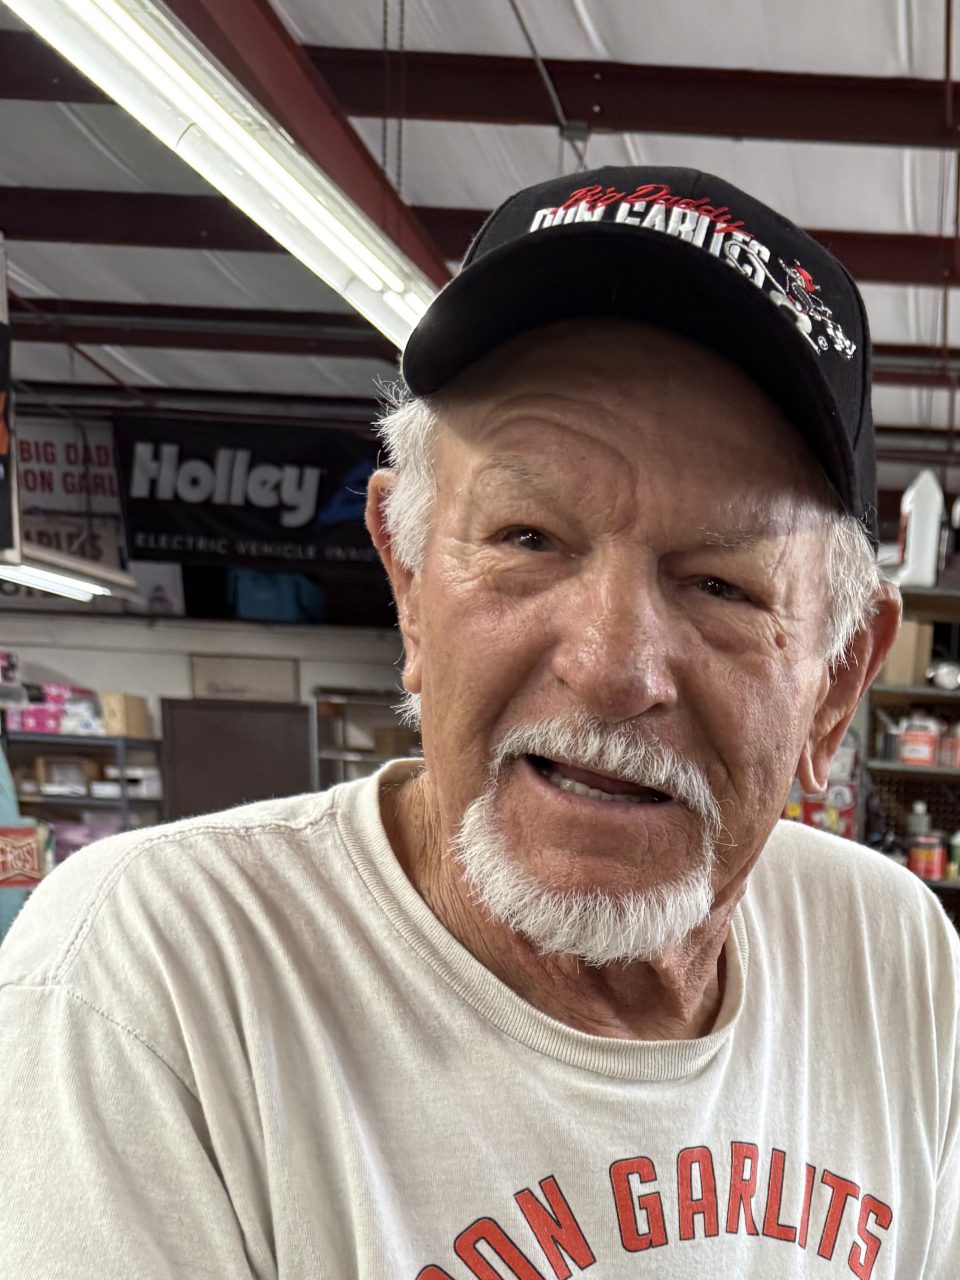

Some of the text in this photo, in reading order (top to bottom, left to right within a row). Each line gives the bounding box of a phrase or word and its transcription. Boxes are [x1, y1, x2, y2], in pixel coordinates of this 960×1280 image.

[19, 440, 112, 467] BIG DAD
[21, 469, 118, 498] ON GARL
[131, 441, 321, 527] Holley
[134, 530, 229, 555] ELECTRIC
[236, 538, 319, 560] VEHICLE
